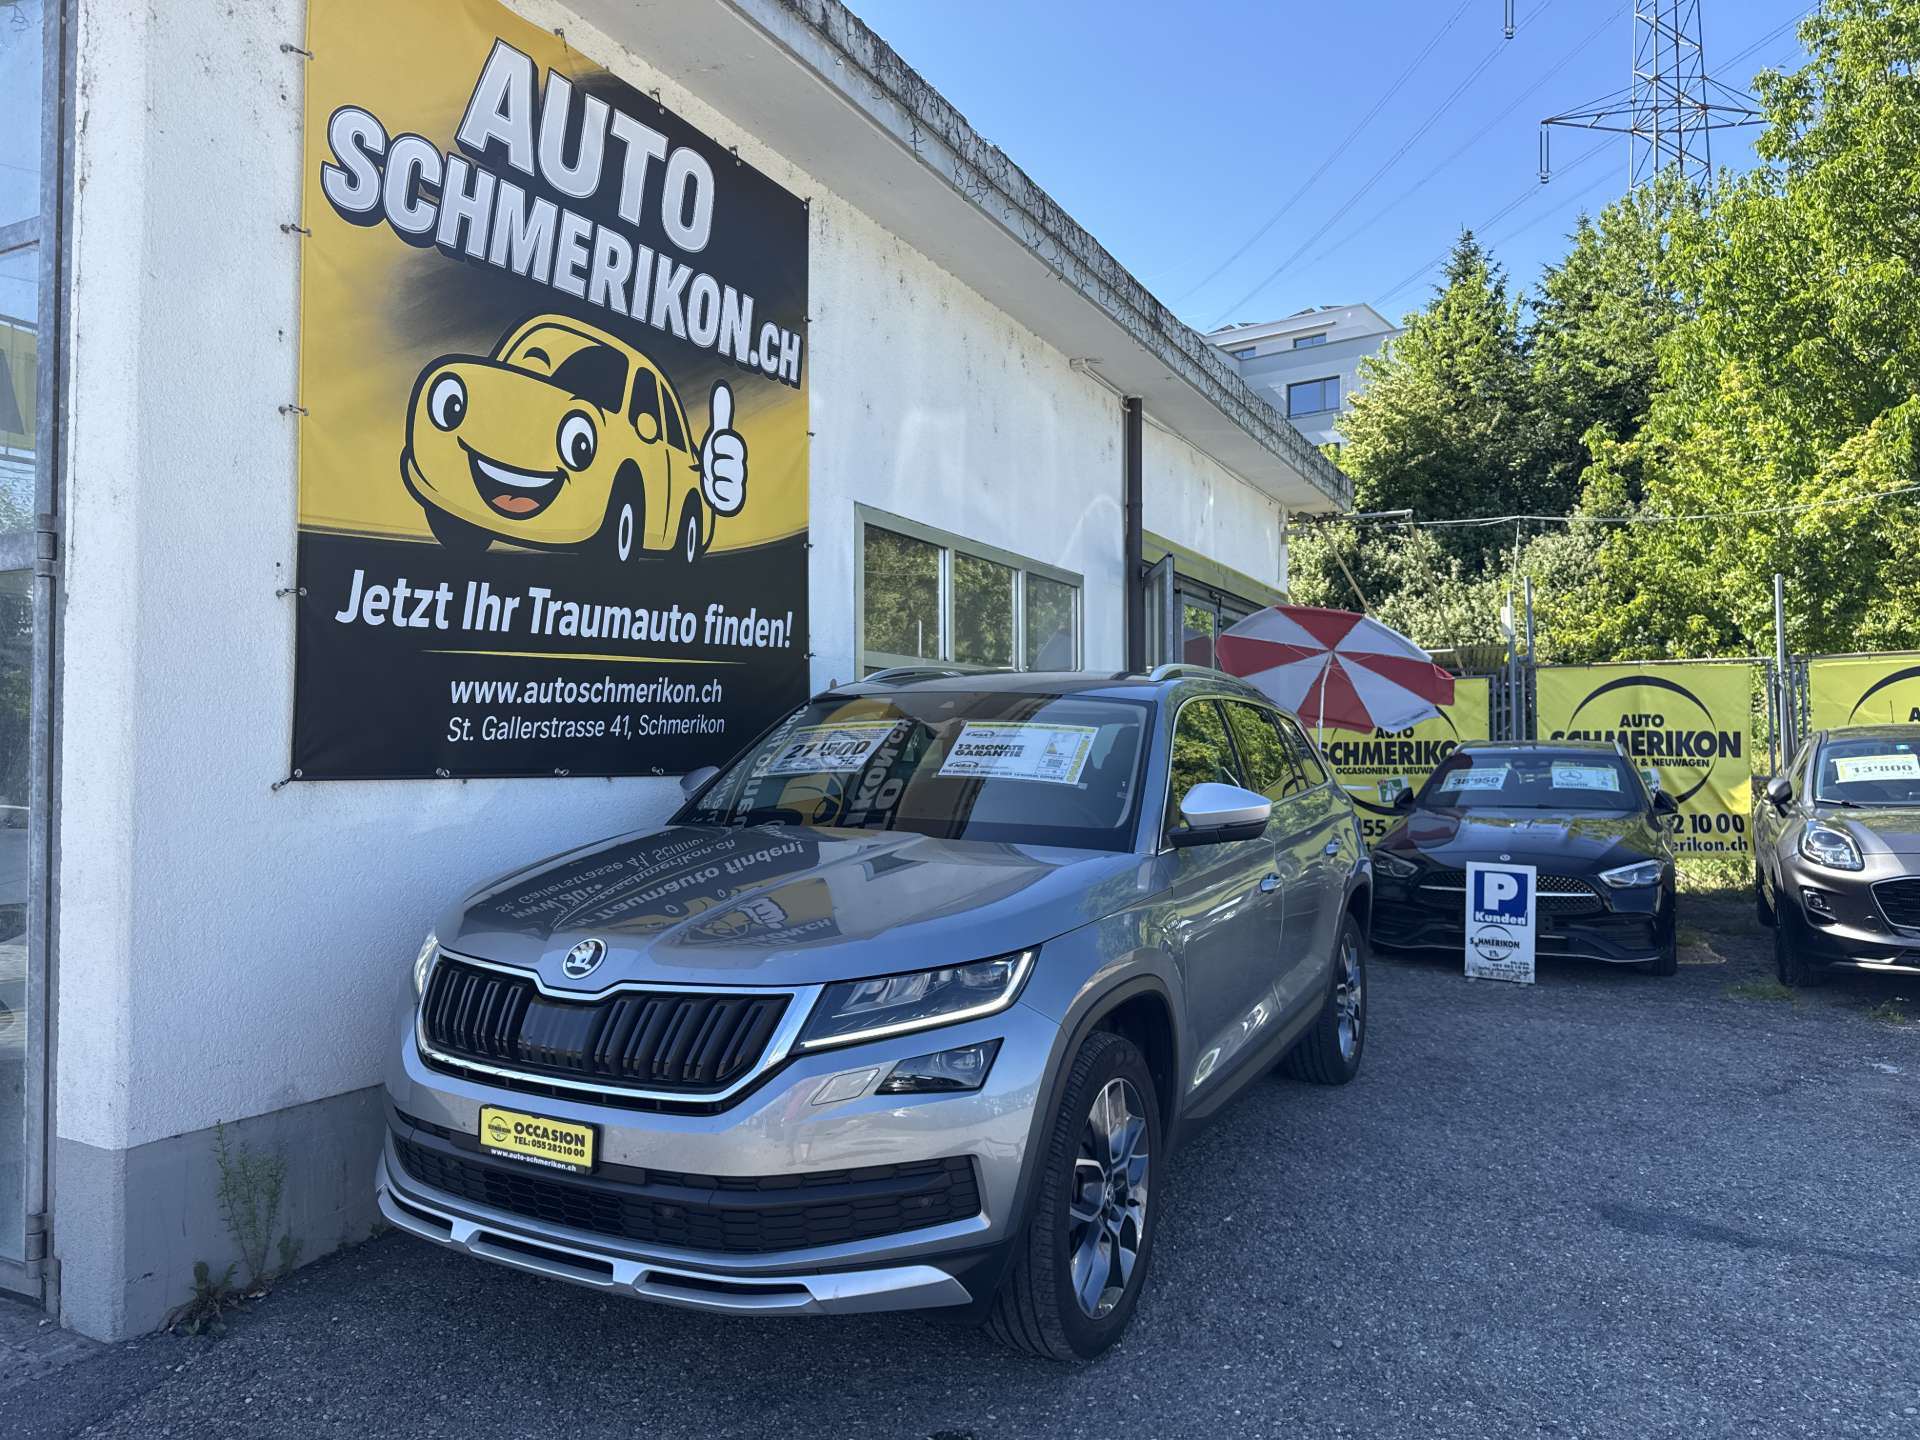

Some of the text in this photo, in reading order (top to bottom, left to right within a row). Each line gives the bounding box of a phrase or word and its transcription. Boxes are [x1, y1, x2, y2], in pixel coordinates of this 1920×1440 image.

[456, 37, 715, 252] AUTO
[321, 105, 802, 386] SCHMERIKON.CH
[335, 569, 793, 648] Jetzt Ihr Traumauto finden!
[450, 676, 722, 705] www.autoschmerikon.ch
[447, 714, 725, 742] St. Gallerstrasse 41, Schmerikon
[1619, 714, 1664, 728] AUTO
[954, 750, 1023, 758] GARANTIE
[957, 743, 972, 751] 12
[1320, 740, 1463, 766] SCHMERIKO
[1336, 766, 1389, 775] OCCASIONEN
[1392, 766, 1400, 775] &
[1640, 759, 1649, 767] &
[1652, 759, 1710, 768] NEUWAGEN
[1360, 819, 1386, 837] 55
[1484, 872, 1519, 911] P
[1474, 911, 1527, 925] Kunden
[514, 1121, 586, 1148] OCCASION
[514, 1135, 530, 1147] TEL:
